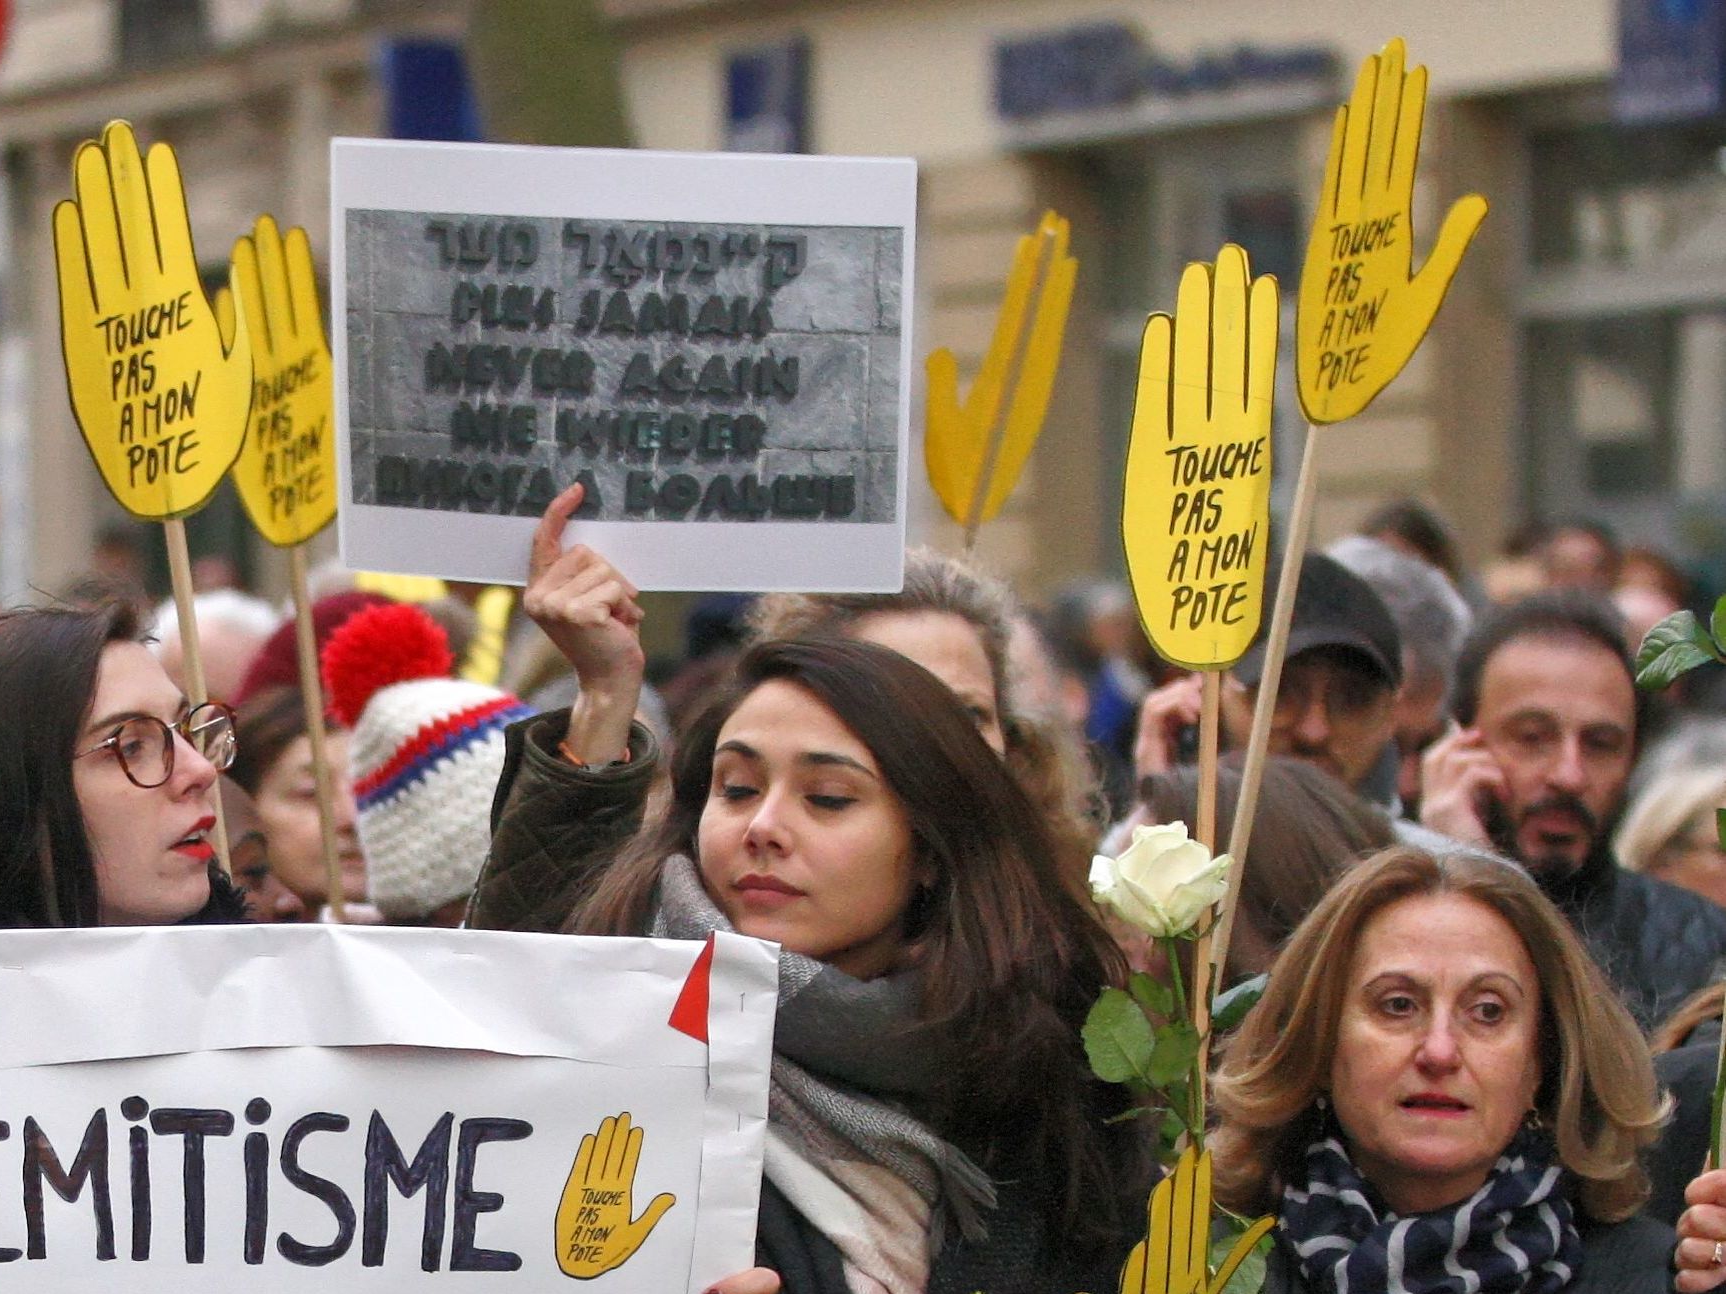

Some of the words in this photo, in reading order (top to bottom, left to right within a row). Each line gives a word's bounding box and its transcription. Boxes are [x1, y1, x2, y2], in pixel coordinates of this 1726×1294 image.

[1330, 212, 1401, 261] TOUCHE
[1324, 262, 1364, 305] PAS
[95, 291, 192, 356] TOUCHE
[573, 289, 774, 342] JAMAIS
[112, 350, 156, 401] PAS
[425, 341, 595, 398] NEVER
[619, 352, 800, 405] AGAIN
[1314, 344, 1371, 391] POTE
[119, 402, 134, 443] A
[143, 369, 202, 438] MON
[450, 401, 538, 454] NIE
[555, 407, 768, 464] WIEDER
[127, 429, 200, 488] POTE
[1165, 436, 1266, 486] TOUCHE
[1169, 488, 1223, 536] PAS
[1167, 539, 1190, 583] A
[1195, 521, 1257, 581] MON
[1169, 581, 1248, 631] POTE
[575, 1206, 601, 1225] PAS
[581, 1188, 626, 1206] TOUCHE
[566, 1243, 604, 1263] POTE
